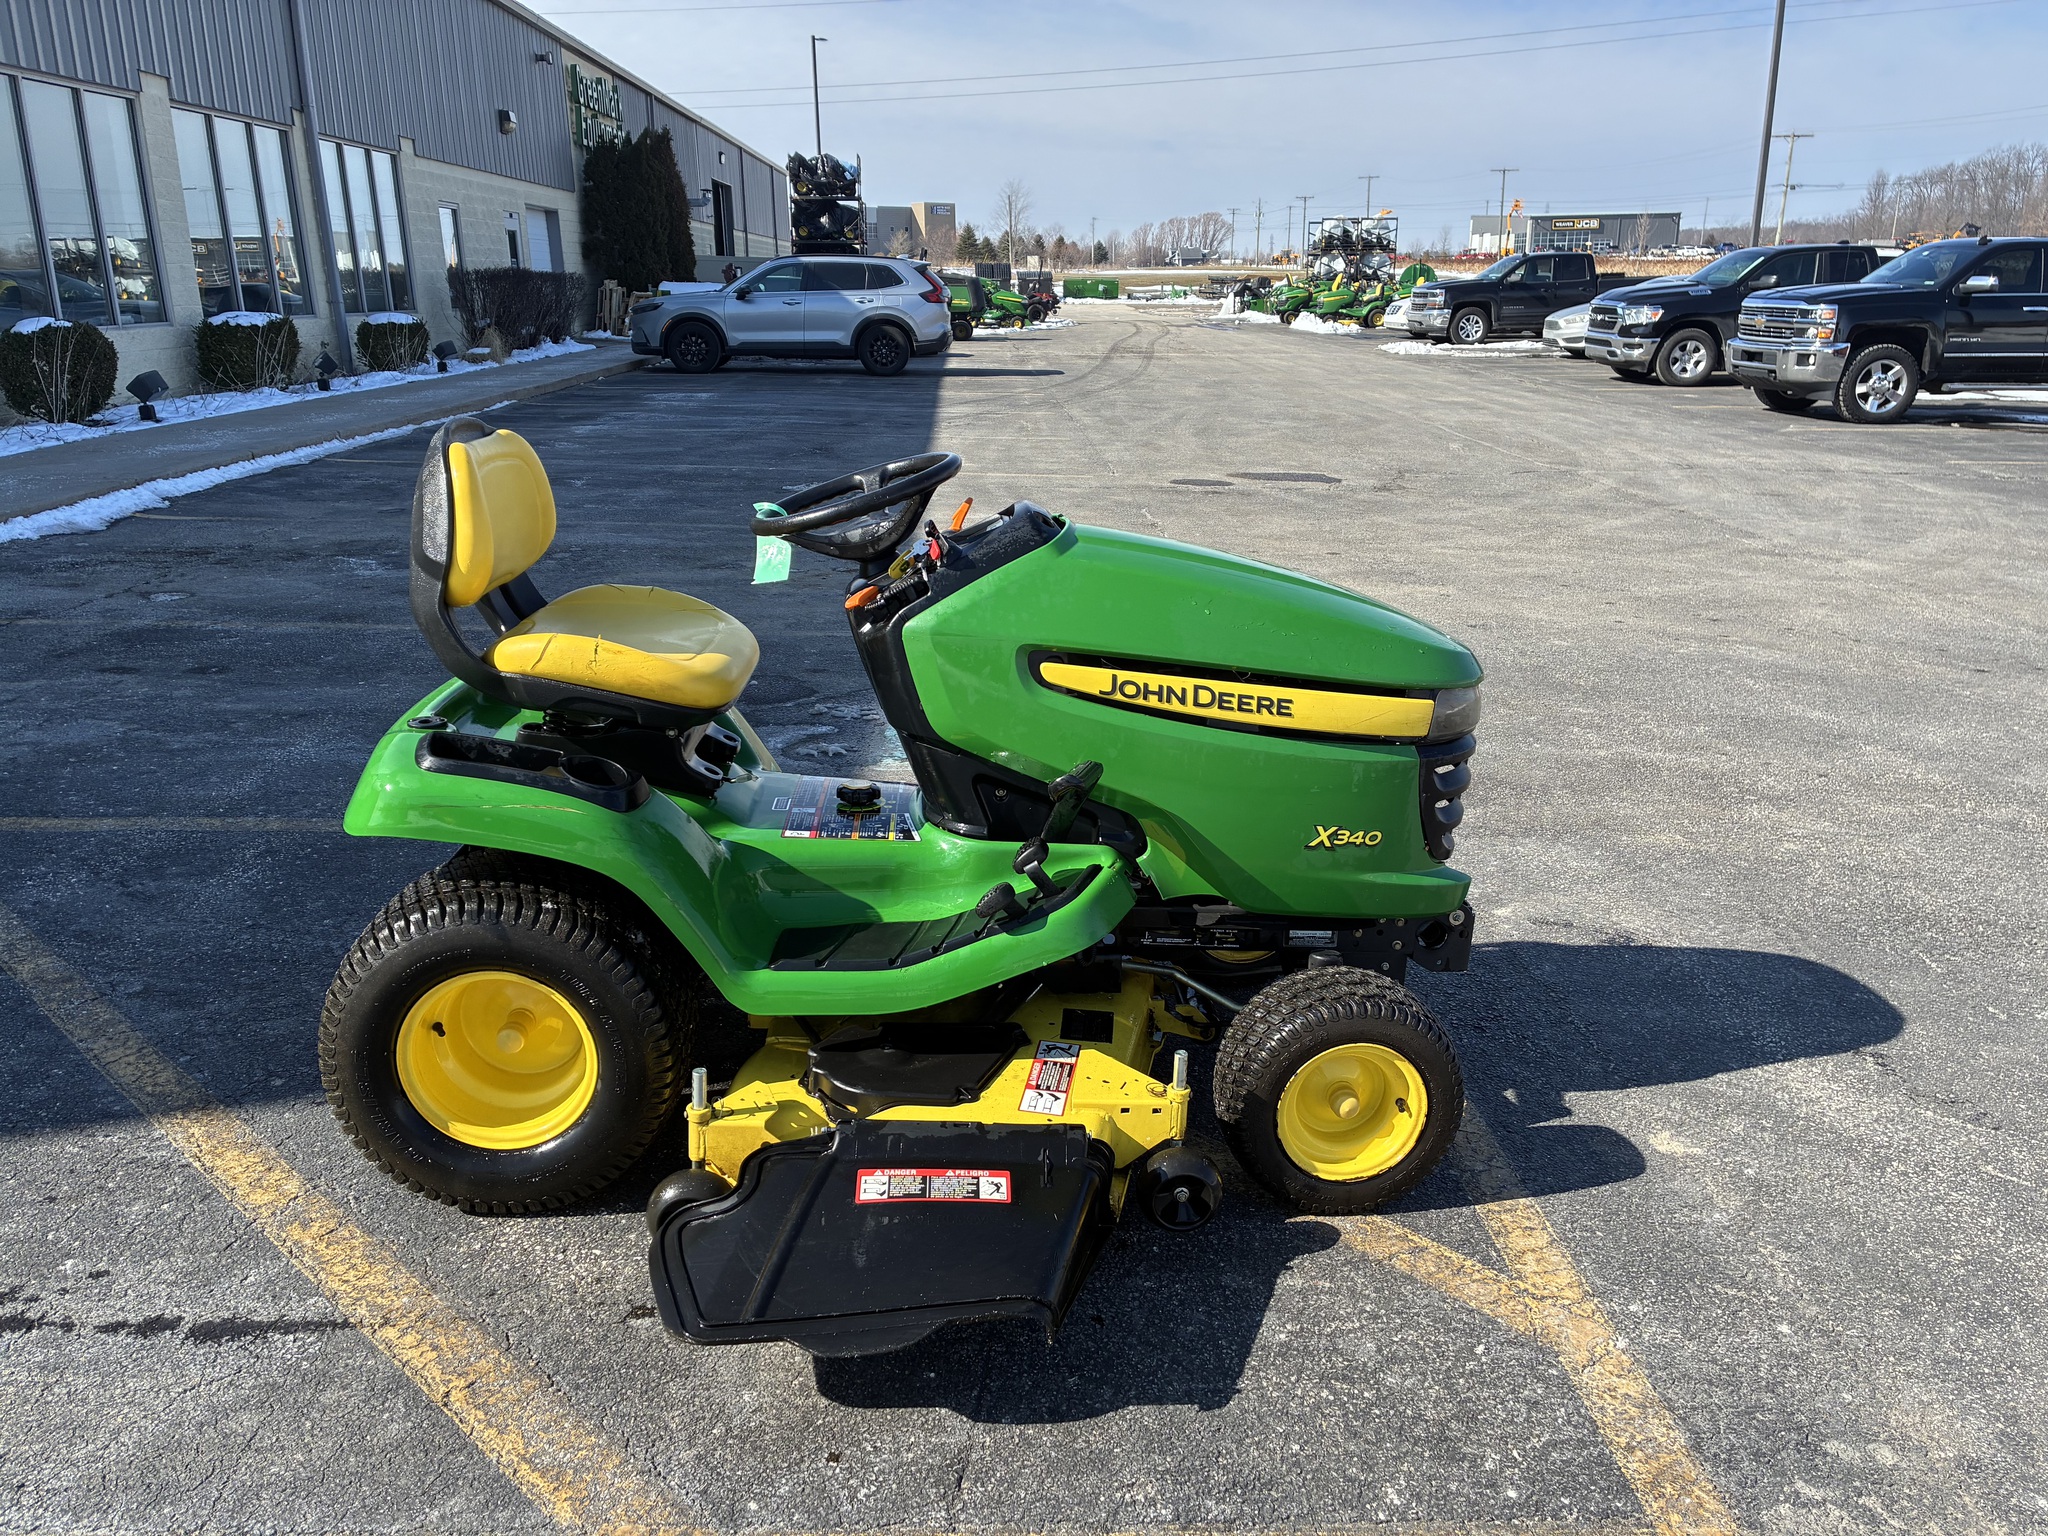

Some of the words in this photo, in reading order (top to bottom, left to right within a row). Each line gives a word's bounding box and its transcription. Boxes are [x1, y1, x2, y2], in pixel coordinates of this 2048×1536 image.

[1576, 219, 1598, 228] JCB
[1098, 674, 1188, 706] JOHN
[1193, 684, 1294, 718] DEERE
[1304, 824, 1383, 850] X340
[1029, 1061, 1041, 1082] DANGER
[955, 1169, 989, 1177] PELIGRO
